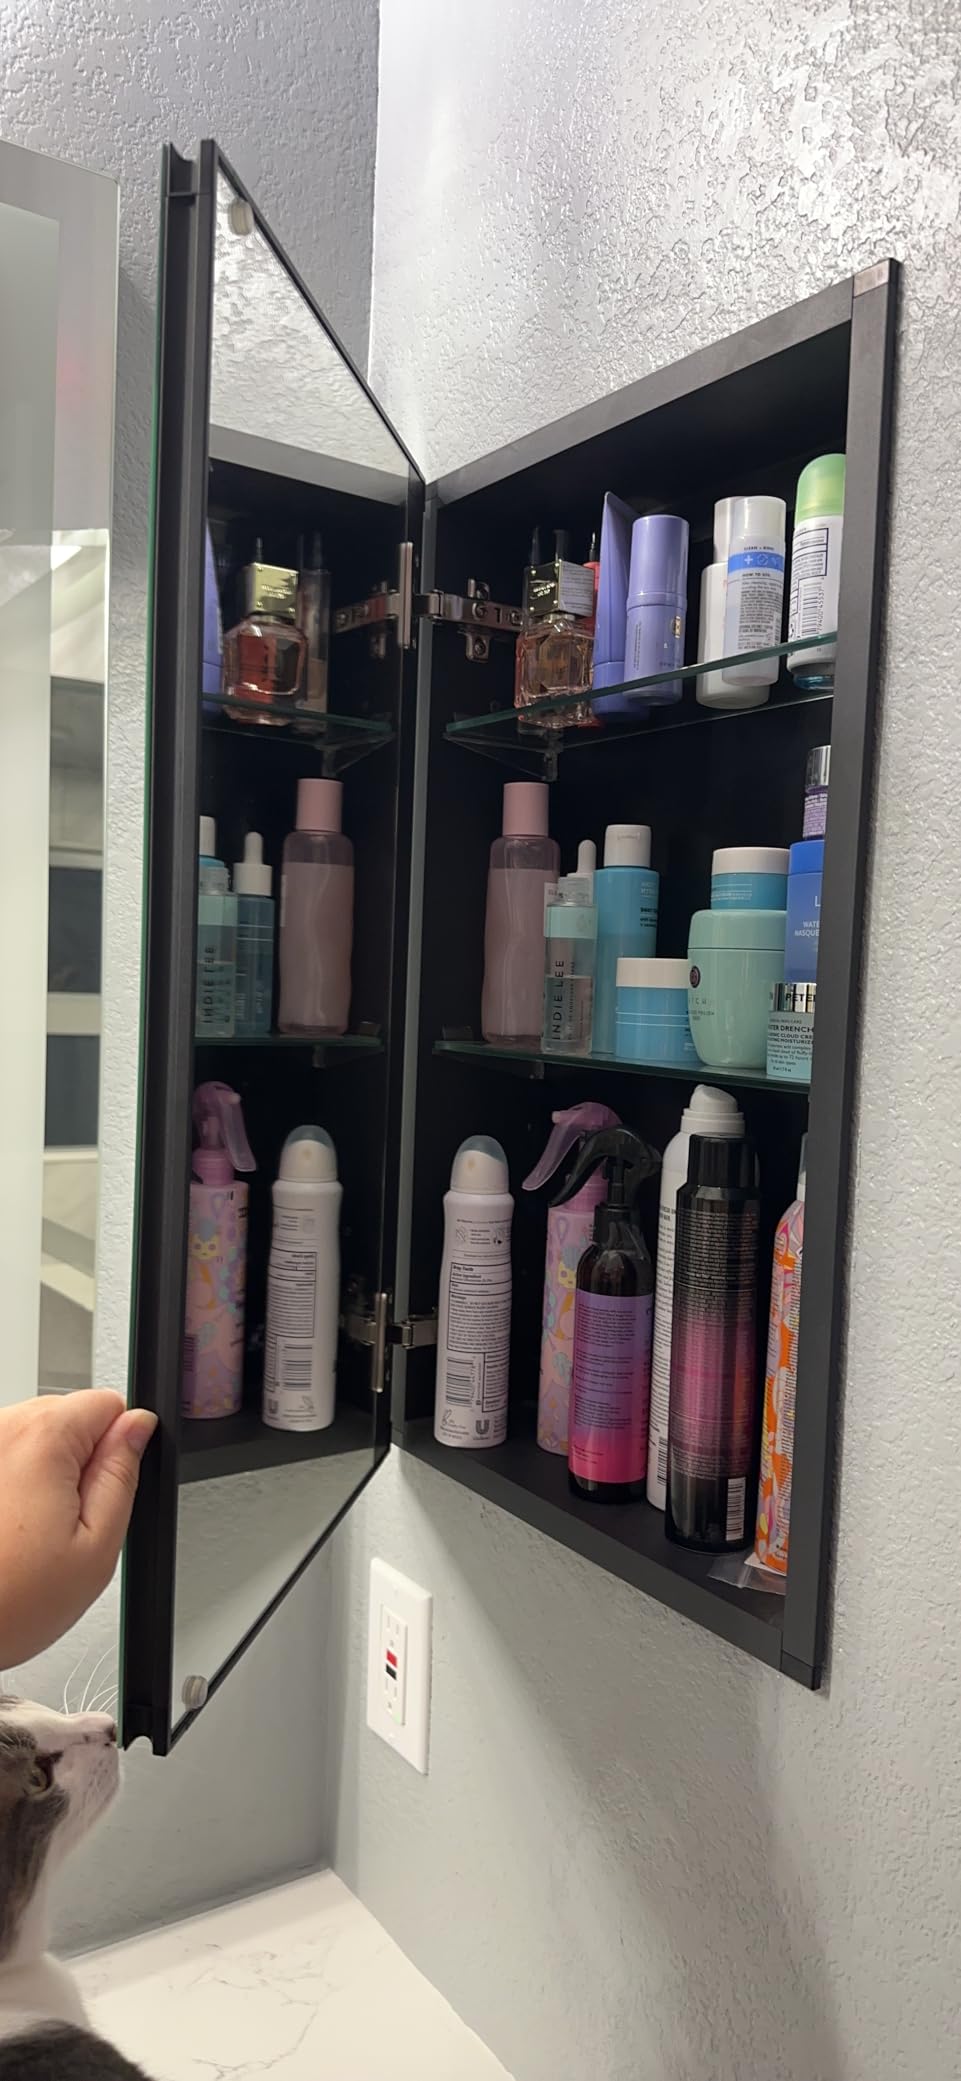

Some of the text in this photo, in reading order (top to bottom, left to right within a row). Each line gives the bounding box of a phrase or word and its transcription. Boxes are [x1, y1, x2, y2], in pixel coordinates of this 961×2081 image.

[552, 960, 564, 1040] INDIE LEE
[786, 994, 816, 1002] PETE
